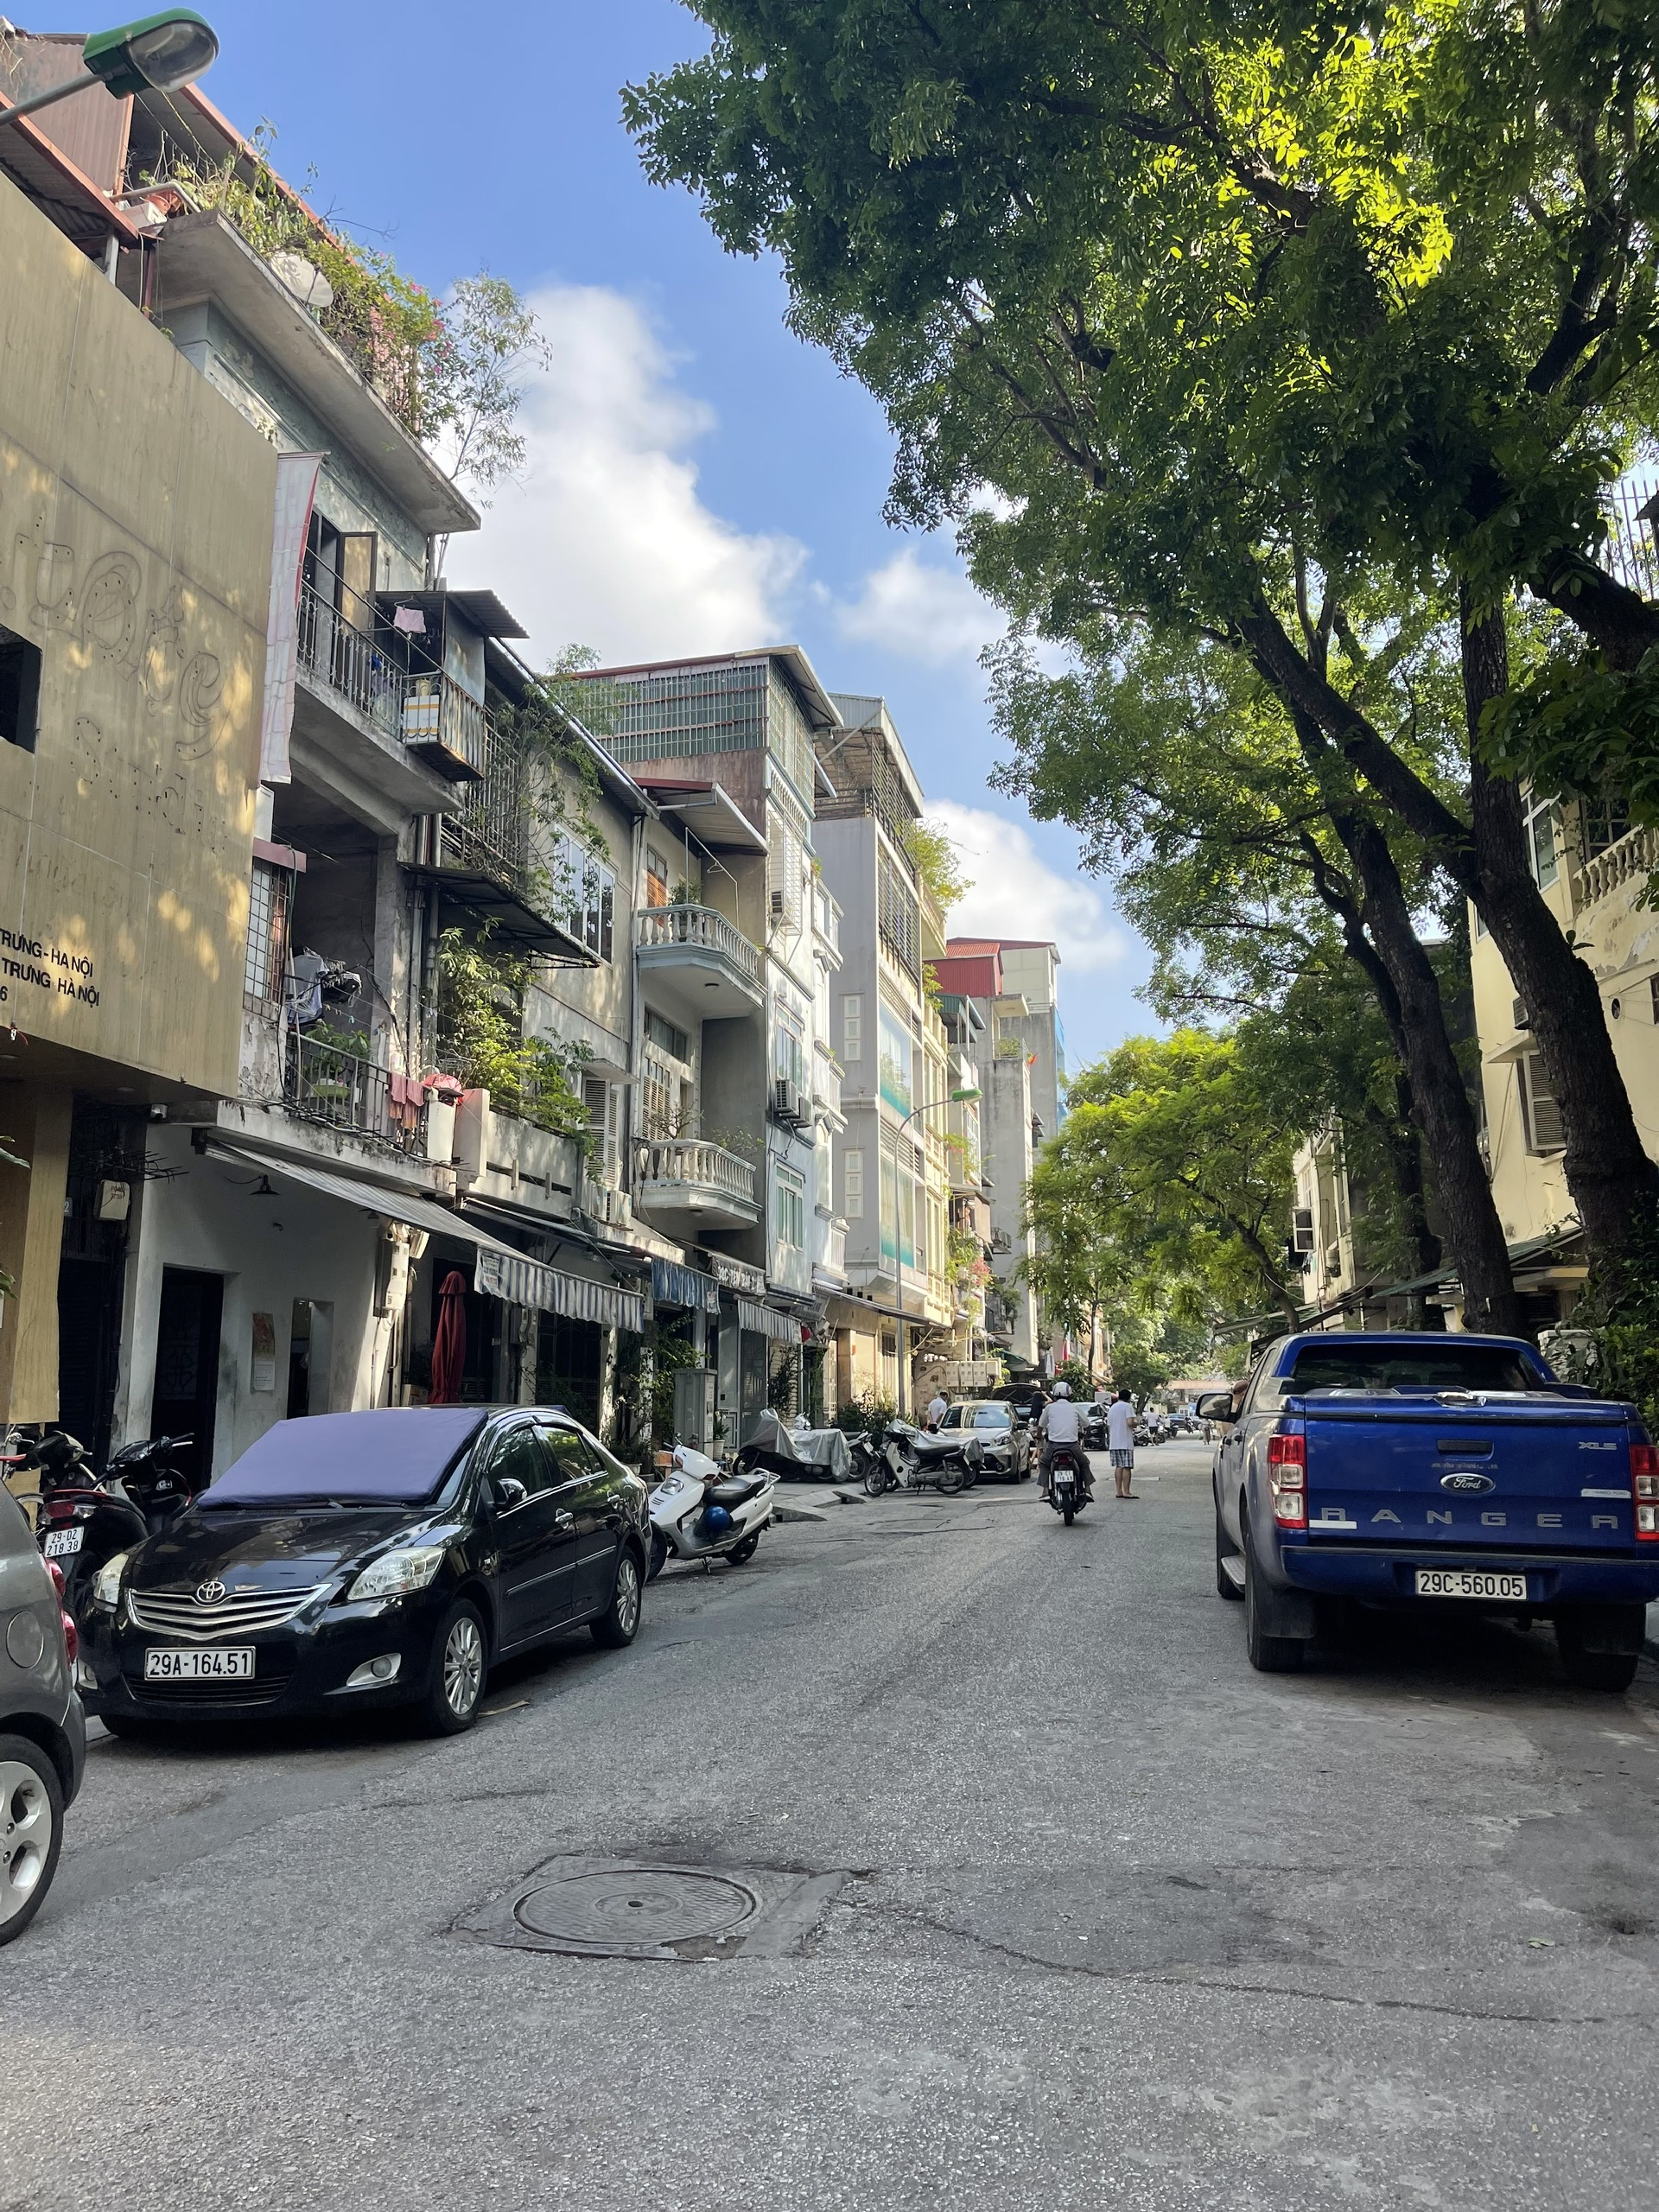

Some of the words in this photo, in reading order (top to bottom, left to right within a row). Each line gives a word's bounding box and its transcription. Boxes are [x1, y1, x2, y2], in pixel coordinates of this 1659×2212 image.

[1453, 1476, 1482, 1490] Ford
[1321, 1507, 1619, 1529] RANGER
[1420, 1573, 1524, 1598] 29C-560.05
[149, 1652, 249, 1676] 29A-164.51
